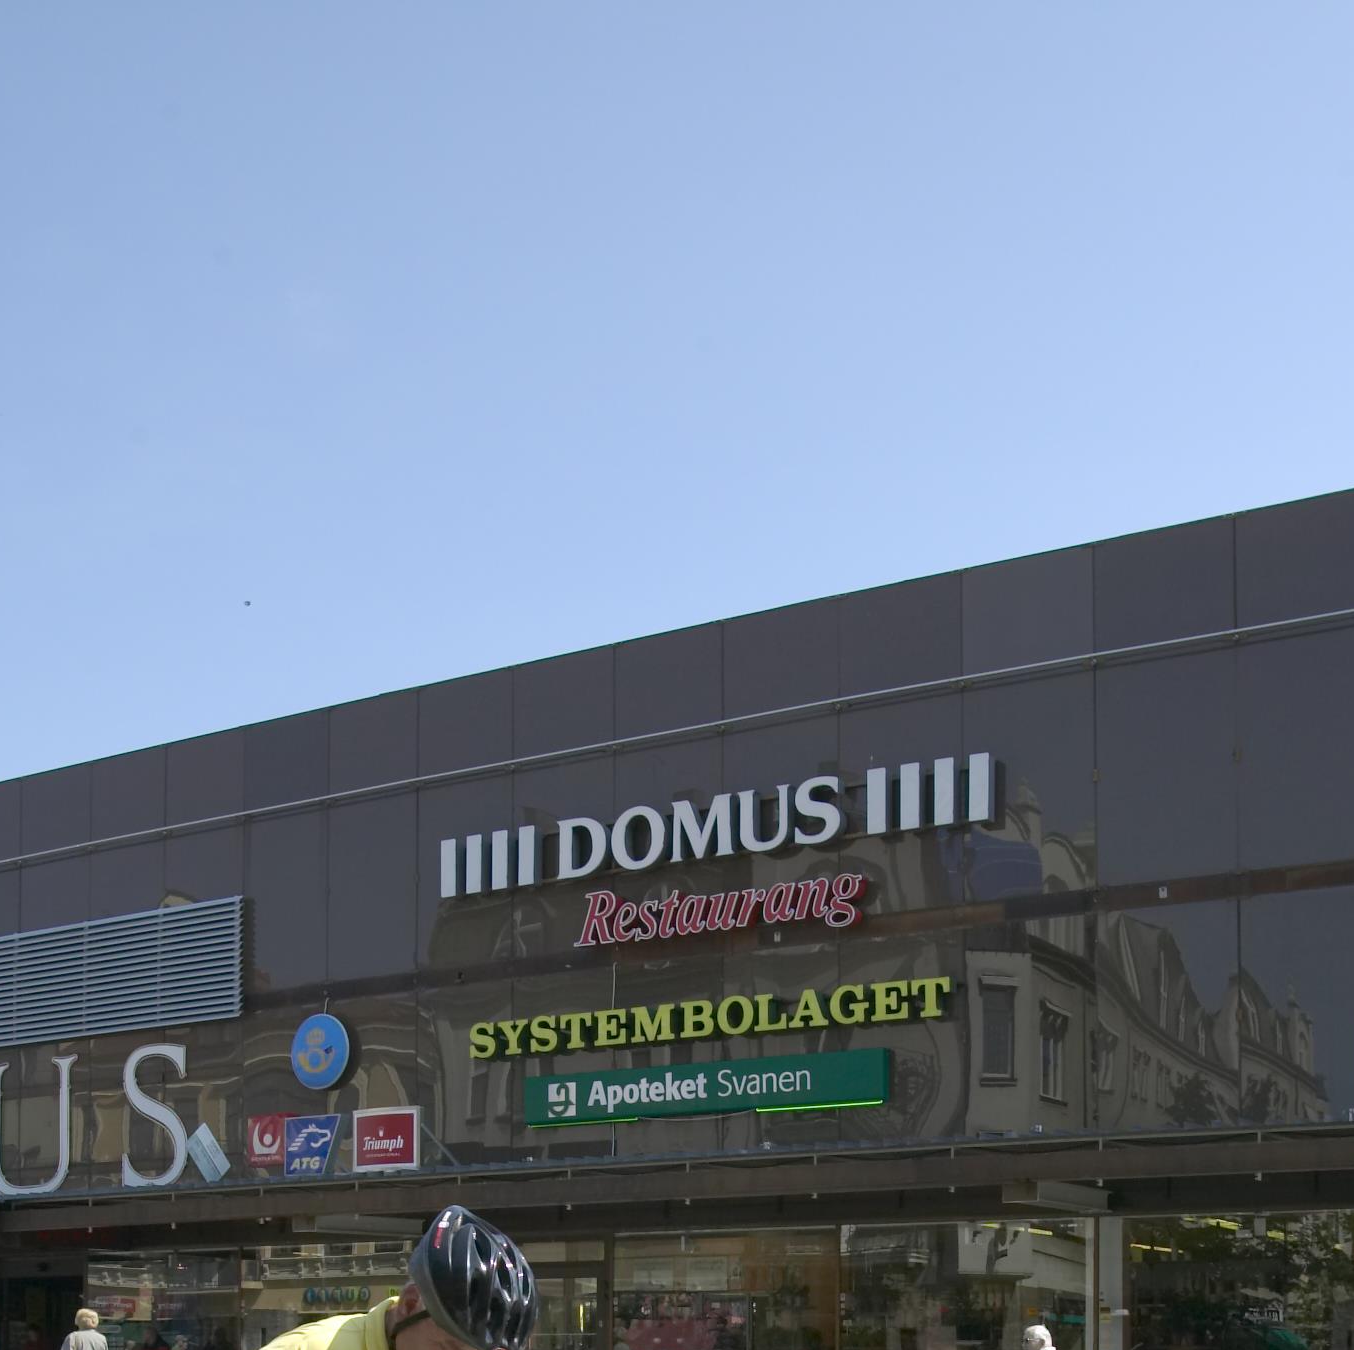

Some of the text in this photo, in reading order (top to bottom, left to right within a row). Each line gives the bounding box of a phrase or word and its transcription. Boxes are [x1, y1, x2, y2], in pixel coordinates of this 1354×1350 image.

[557, 776, 843, 880] DOMUS
[575, 873, 867, 947] Restaurang
[470, 976, 951, 1060] SYSTEMBOLAGET
[587, 1065, 811, 1112] Apoteket Svanen
[290, 1156, 321, 1171] ATG
[363, 1135, 404, 1152] Triumph
